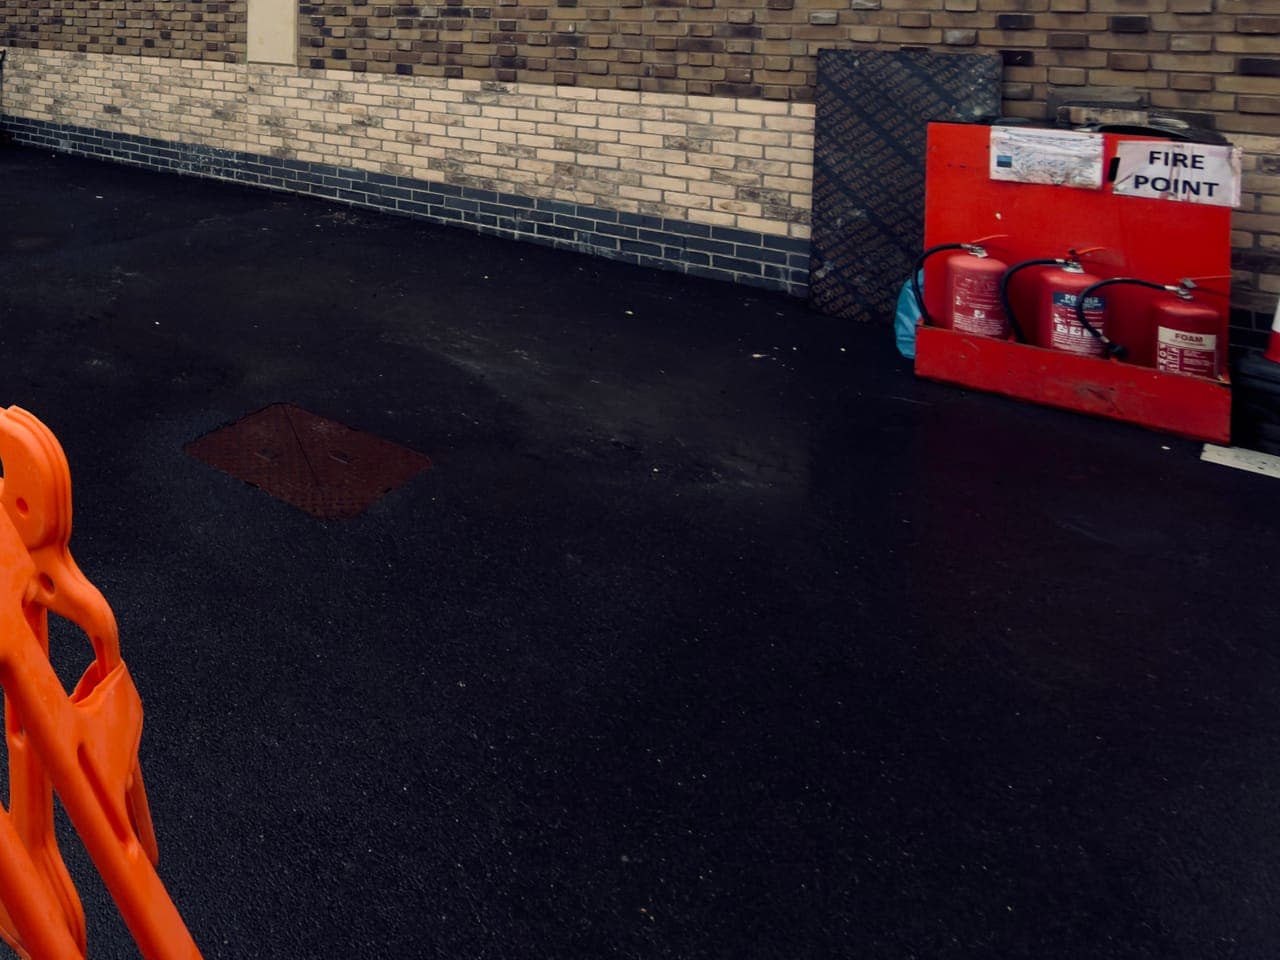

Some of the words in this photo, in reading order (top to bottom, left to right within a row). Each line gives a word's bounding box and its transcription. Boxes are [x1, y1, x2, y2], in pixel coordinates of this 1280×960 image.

[1149, 151, 1205, 169] FIRE
[1134, 175, 1219, 197] POINT
[1175, 333, 1203, 343] FOAM
